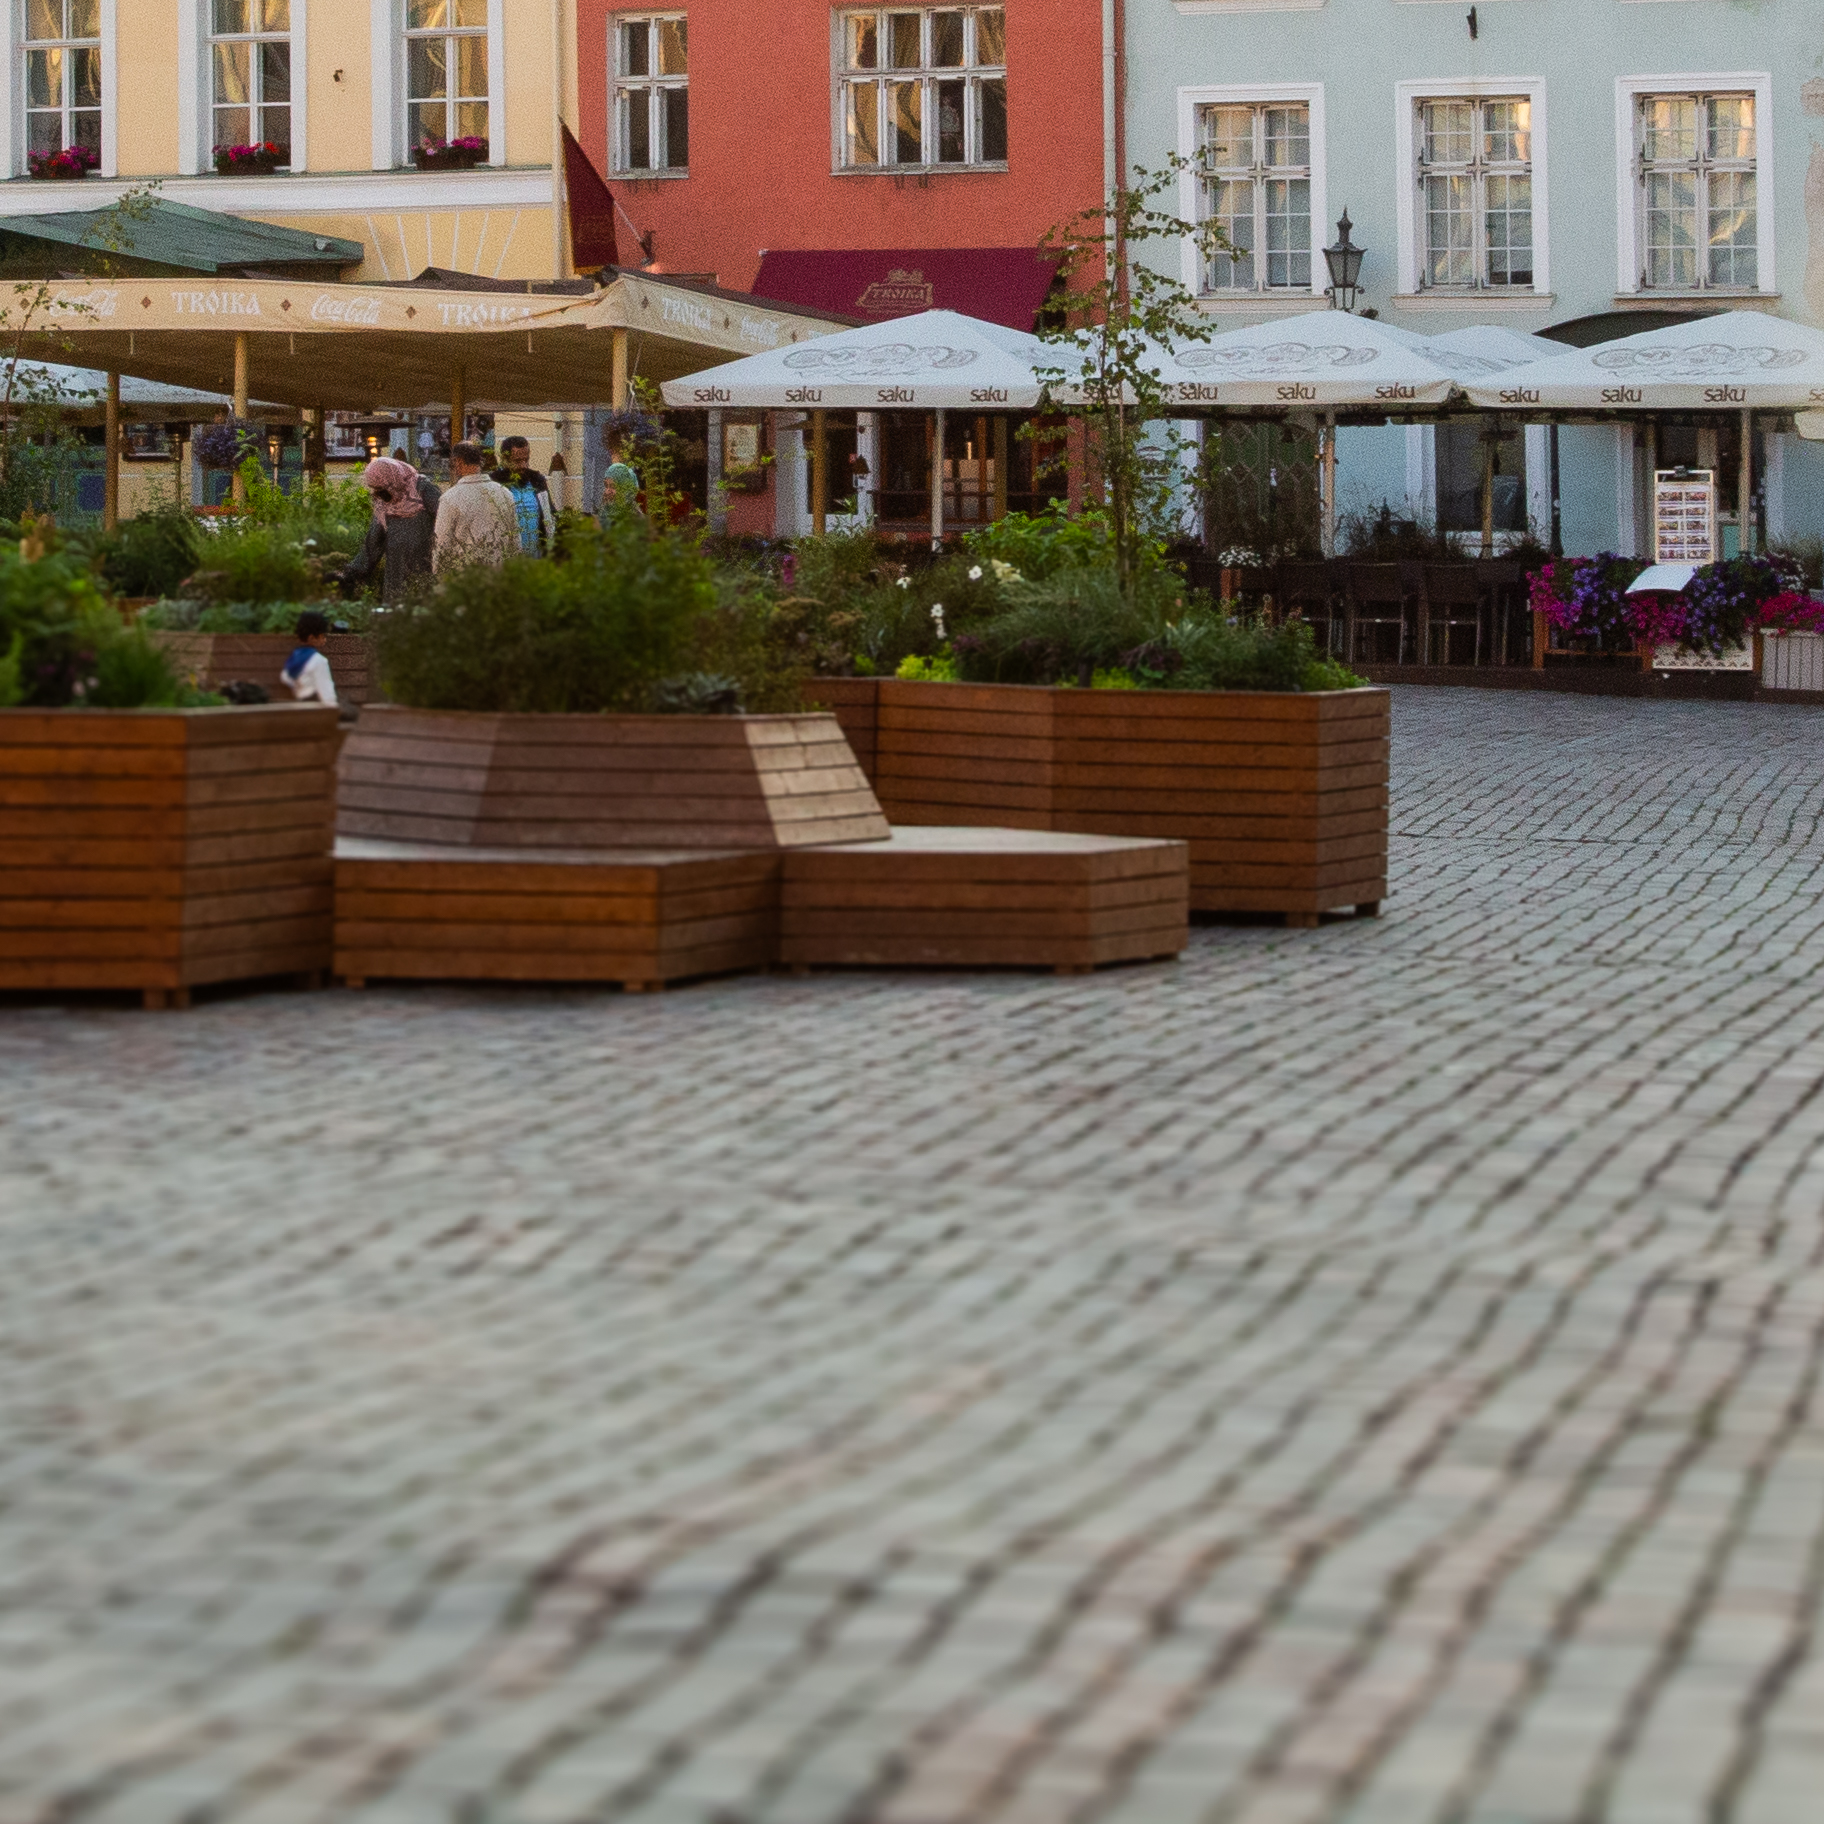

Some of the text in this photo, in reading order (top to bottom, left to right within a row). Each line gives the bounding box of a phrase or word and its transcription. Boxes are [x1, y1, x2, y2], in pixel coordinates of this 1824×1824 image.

[172, 291, 260, 316] TROIKA
[694, 385, 1008, 403] saku saku saku saku
[1179, 381, 1218, 401] saku
[1277, 382, 1316, 401] saku
[1375, 381, 1416, 400] saku
[1499, 386, 1540, 404] saku
[1600, 385, 1642, 404] saku
[1704, 384, 1746, 403] saku
